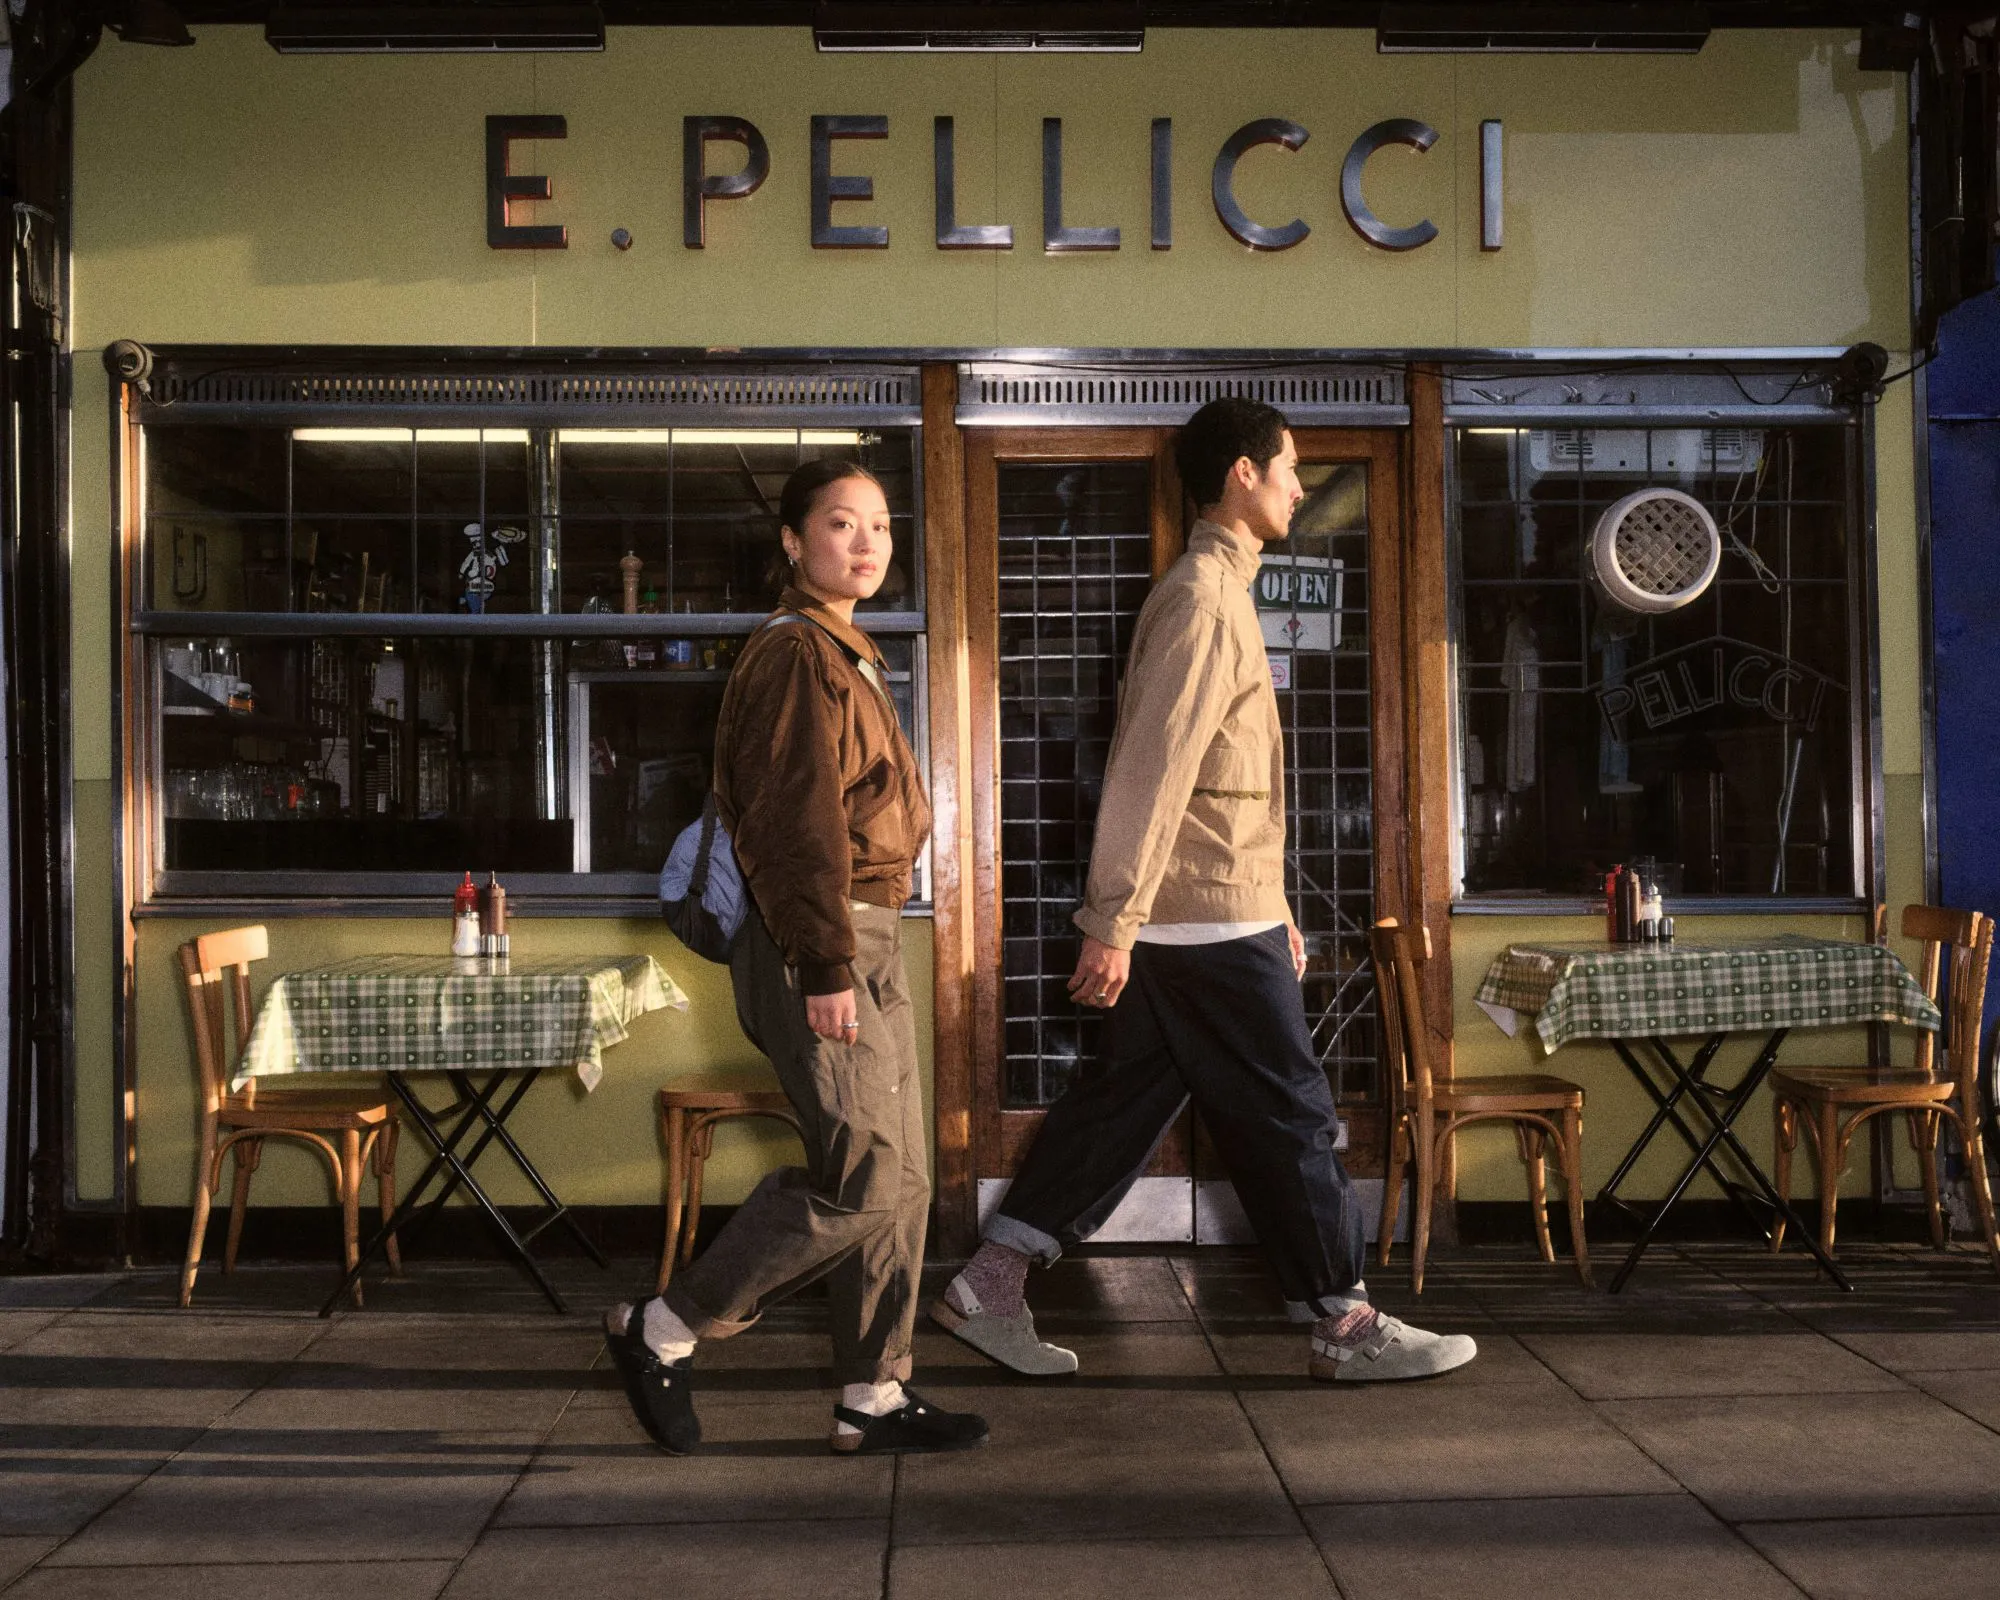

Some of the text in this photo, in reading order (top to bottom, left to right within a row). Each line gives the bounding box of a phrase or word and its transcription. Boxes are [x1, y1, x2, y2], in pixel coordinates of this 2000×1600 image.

[485, 114, 1504, 252] E. PELLICCI
[1261, 572, 1330, 605] OPEN
[1594, 648, 1829, 742] PELLICCI
